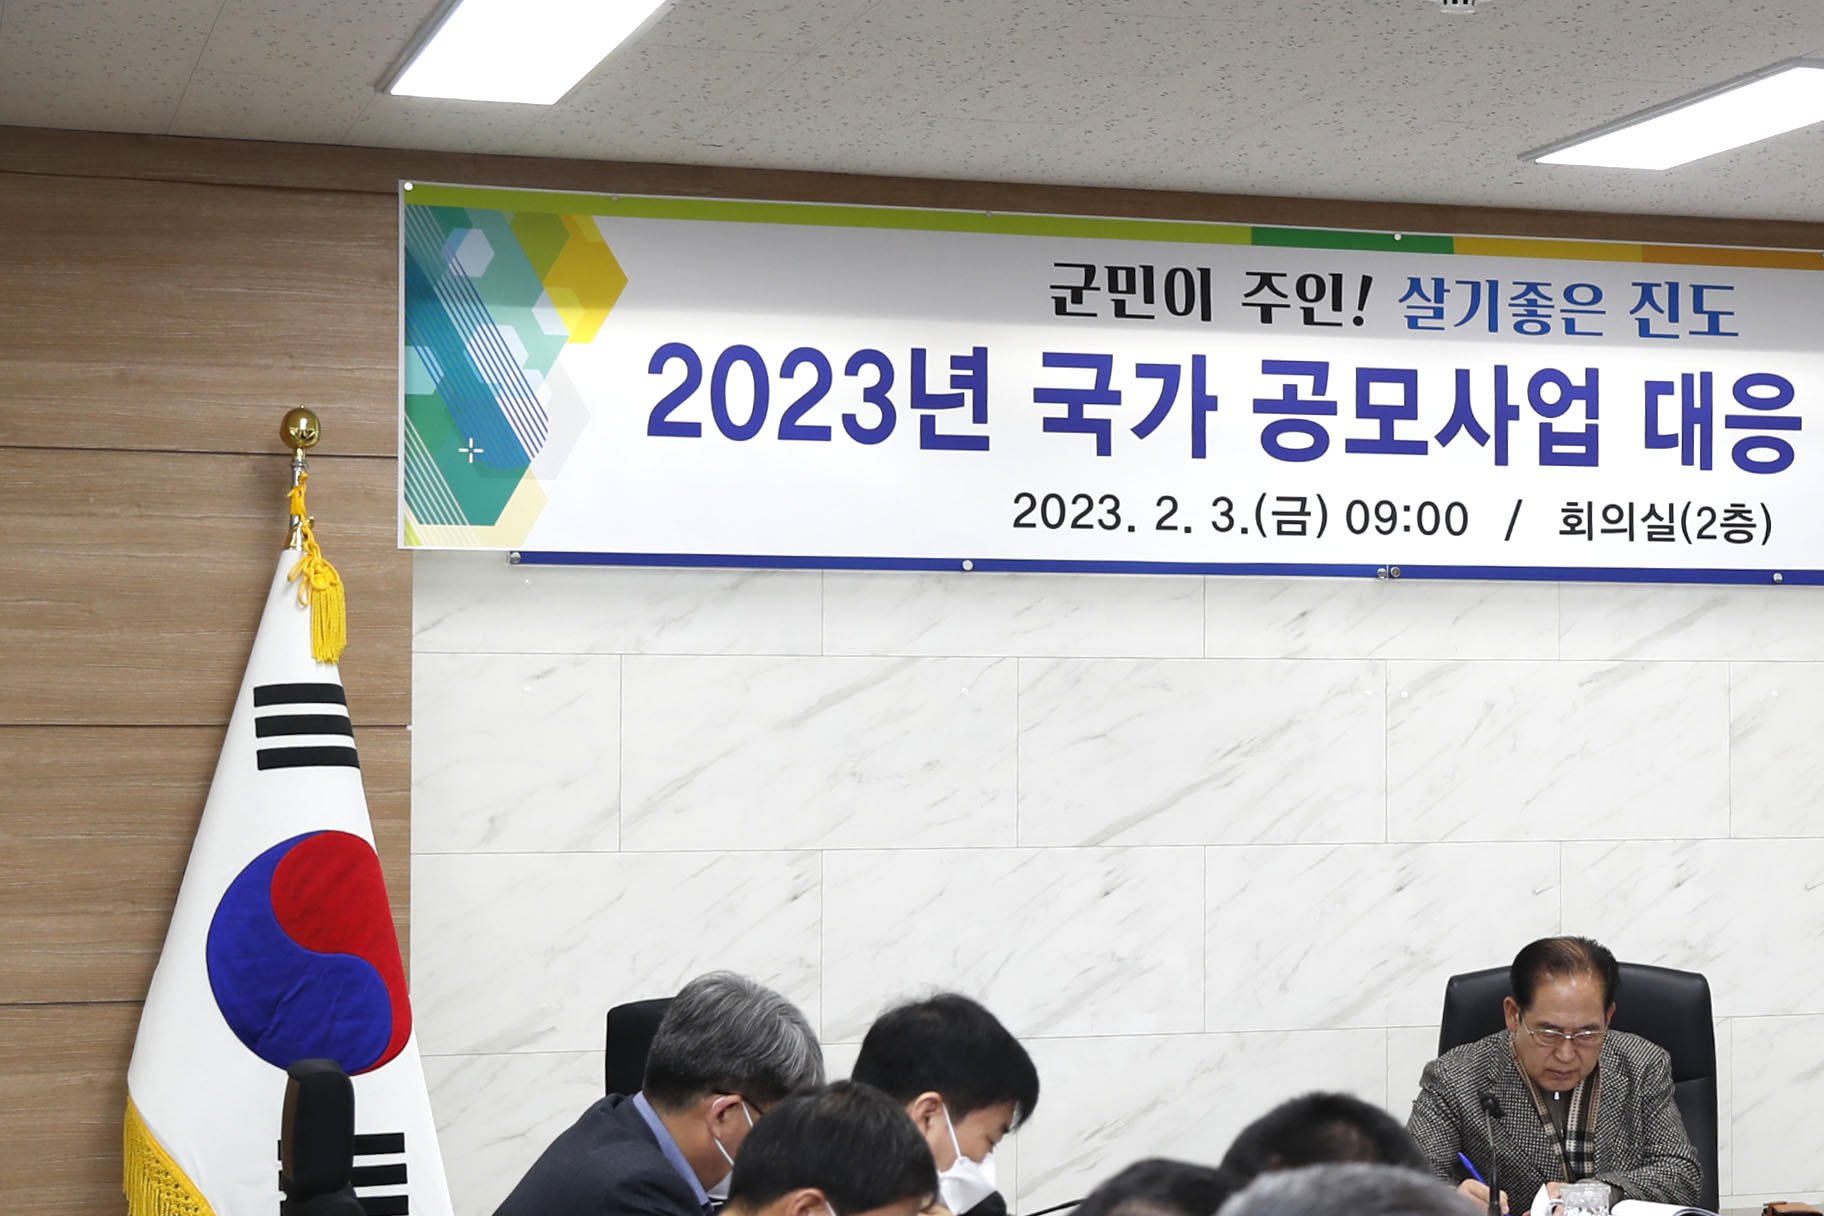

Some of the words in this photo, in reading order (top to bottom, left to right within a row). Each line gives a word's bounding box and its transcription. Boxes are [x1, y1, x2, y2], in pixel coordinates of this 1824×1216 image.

[1049, 262, 1212, 322] 군민이
[1241, 270, 1373, 328] 주인!
[1399, 276, 1605, 337] 살기좋은
[1629, 281, 1741, 339] 진도
[646, 342, 990, 452] 2023년
[1033, 352, 1218, 459] 국가
[1253, 359, 1602, 468] 공모사업
[1643, 371, 1803, 475] 대응
[1013, 492, 1136, 533] 2023.
[1155, 495, 1192, 534] 2.
[1210, 492, 1329, 539] 3.(금)
[1345, 500, 1469, 537] 09:00
[1558, 500, 1772, 546] 회의실(2층)
